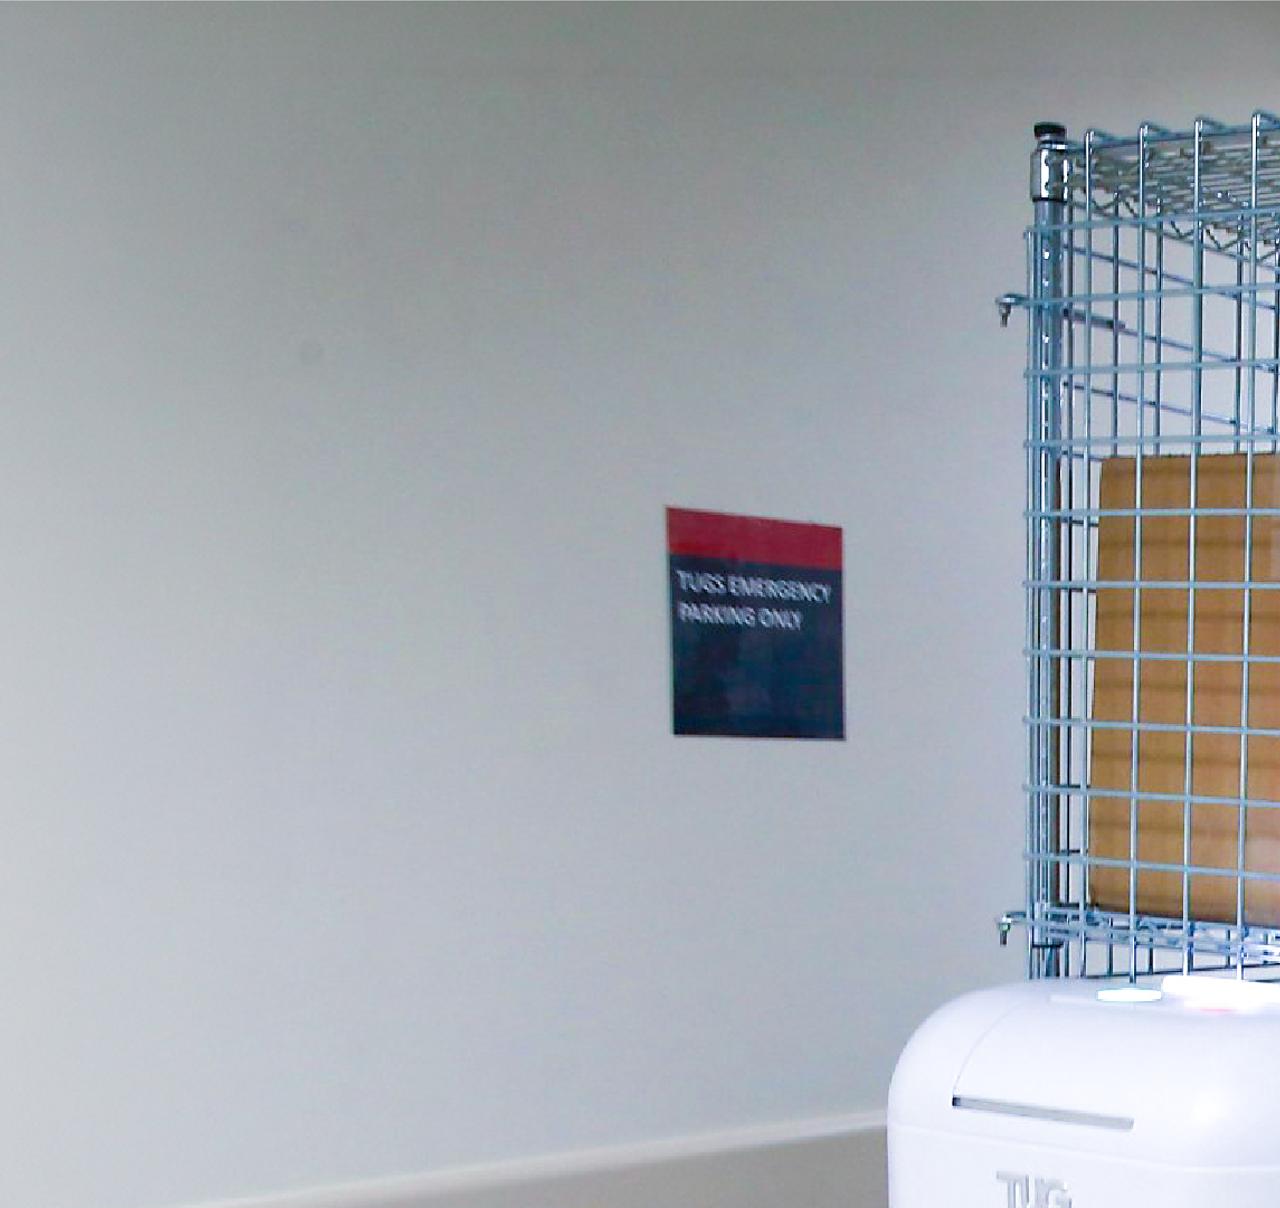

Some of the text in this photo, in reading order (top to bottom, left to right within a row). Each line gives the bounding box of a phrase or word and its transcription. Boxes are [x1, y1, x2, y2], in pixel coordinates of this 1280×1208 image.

[674, 569, 832, 604] TUGS EMERGENCY
[678, 602, 803, 631] PARKING ONLY
